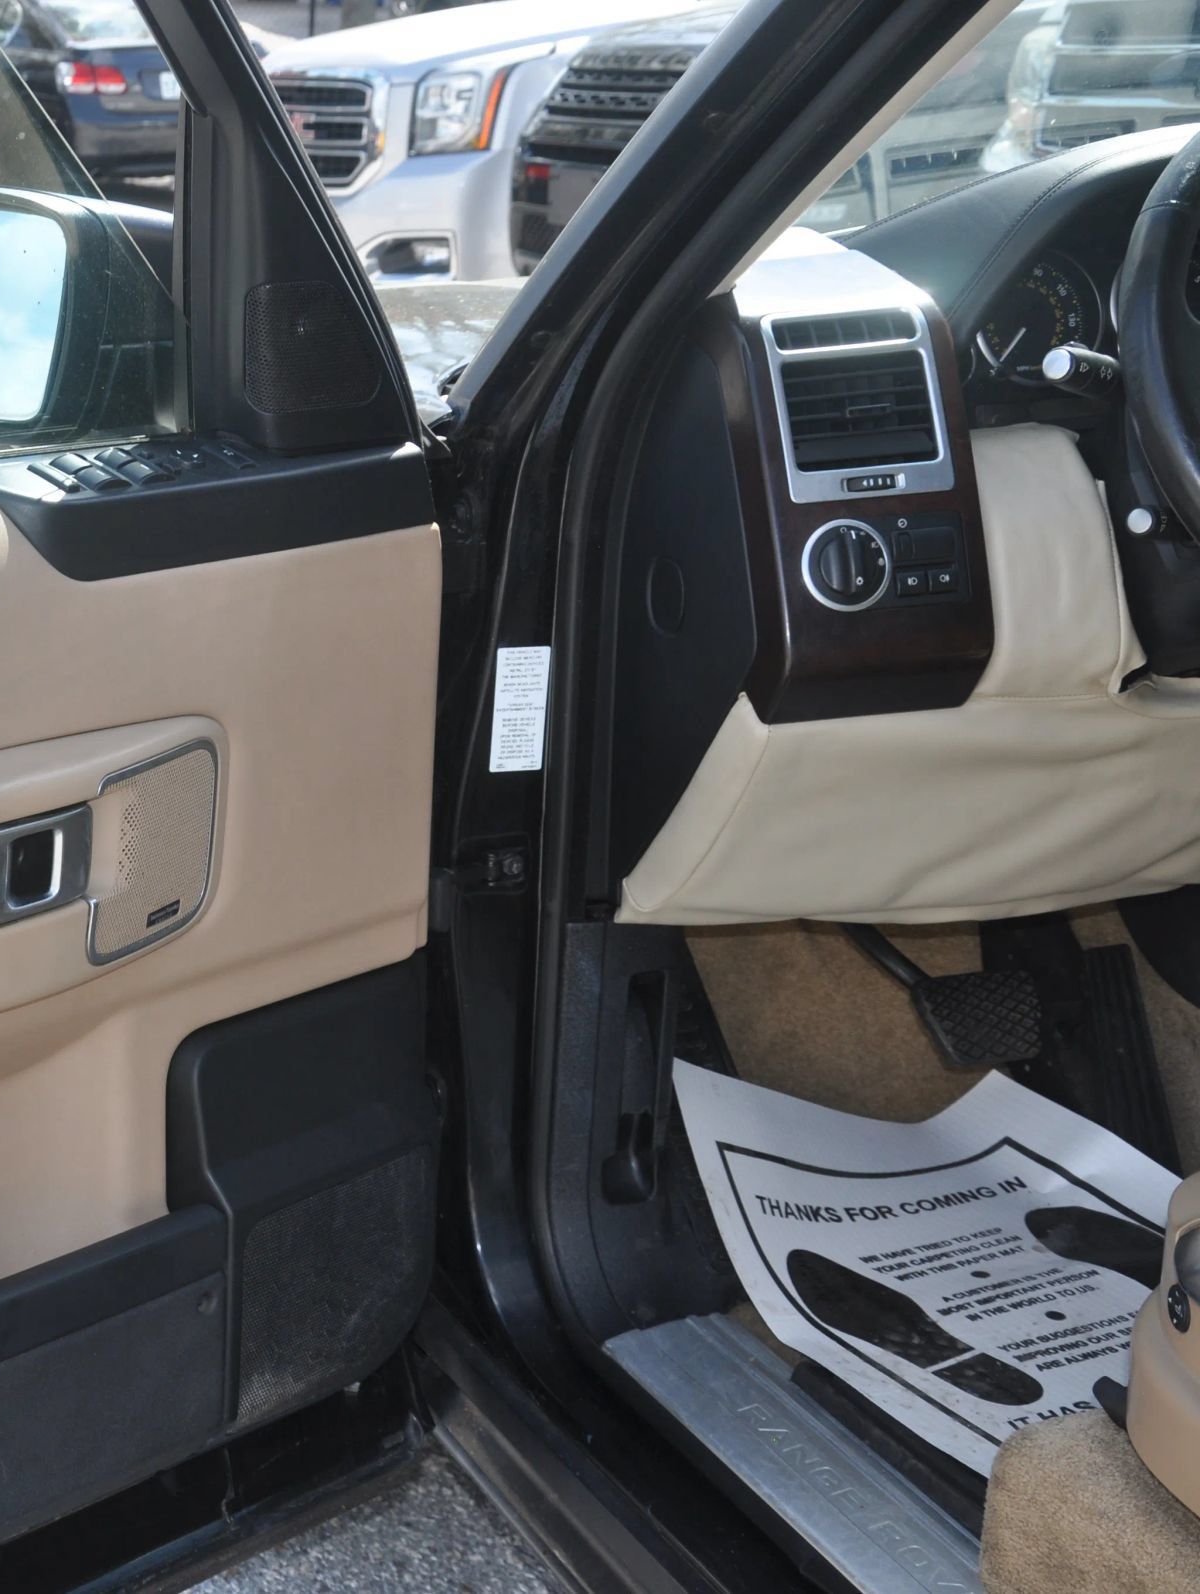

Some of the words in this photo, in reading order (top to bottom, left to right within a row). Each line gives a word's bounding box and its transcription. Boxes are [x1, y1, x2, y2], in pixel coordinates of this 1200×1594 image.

[1068, 313, 1076, 327] 130
[755, 1195, 843, 1223] THANKS
[845, 1206, 898, 1222] FOR
[900, 1185, 997, 1215] COMING
[998, 1176, 1028, 1193] IN
[859, 1255, 883, 1264] WE
[880, 1248, 915, 1260] HAVE
[914, 1240, 952, 1252] TRIED
[952, 1235, 971, 1244] TO
[970, 1227, 1002, 1240] KEEP
[872, 1262, 911, 1274] YOUR
[910, 1245, 981, 1266] CARPETING
[980, 1235, 1023, 1249] CLEAN
[894, 1270, 929, 1282] WITH
[927, 1263, 958, 1275] THIS
[956, 1252, 999, 1267] PAPER
[999, 1245, 1025, 1257] MAT
[936, 1303, 975, 1316] MOST
[975, 1283, 1049, 1306] IMPORTANT
[1046, 1269, 1100, 1287] PERSON
[952, 1278, 1022, 1300] CUSTOMER
[1020, 1274, 1036, 1283] IS
[1035, 1267, 1063, 1279] THE
[965, 1312, 984, 1322] IN
[983, 1305, 1010, 1318] THE
[1007, 1294, 1056, 1310] WORLD
[1056, 1289, 1076, 1298] TO
[997, 1338, 1038, 1352] YOUR
[1036, 1315, 1129, 1343] SUGGESTIONS
[1012, 1339, 1089, 1363] IMPROVING
[1088, 1331, 1121, 1344] OUR
[1035, 1359, 1066, 1372] ARE
[1064, 1346, 1119, 1365] ALWAYS
[1007, 1416, 1030, 1430] IT
[737, 1403, 868, 1511] RANGE
[867, 1519, 978, 1594] ROV
